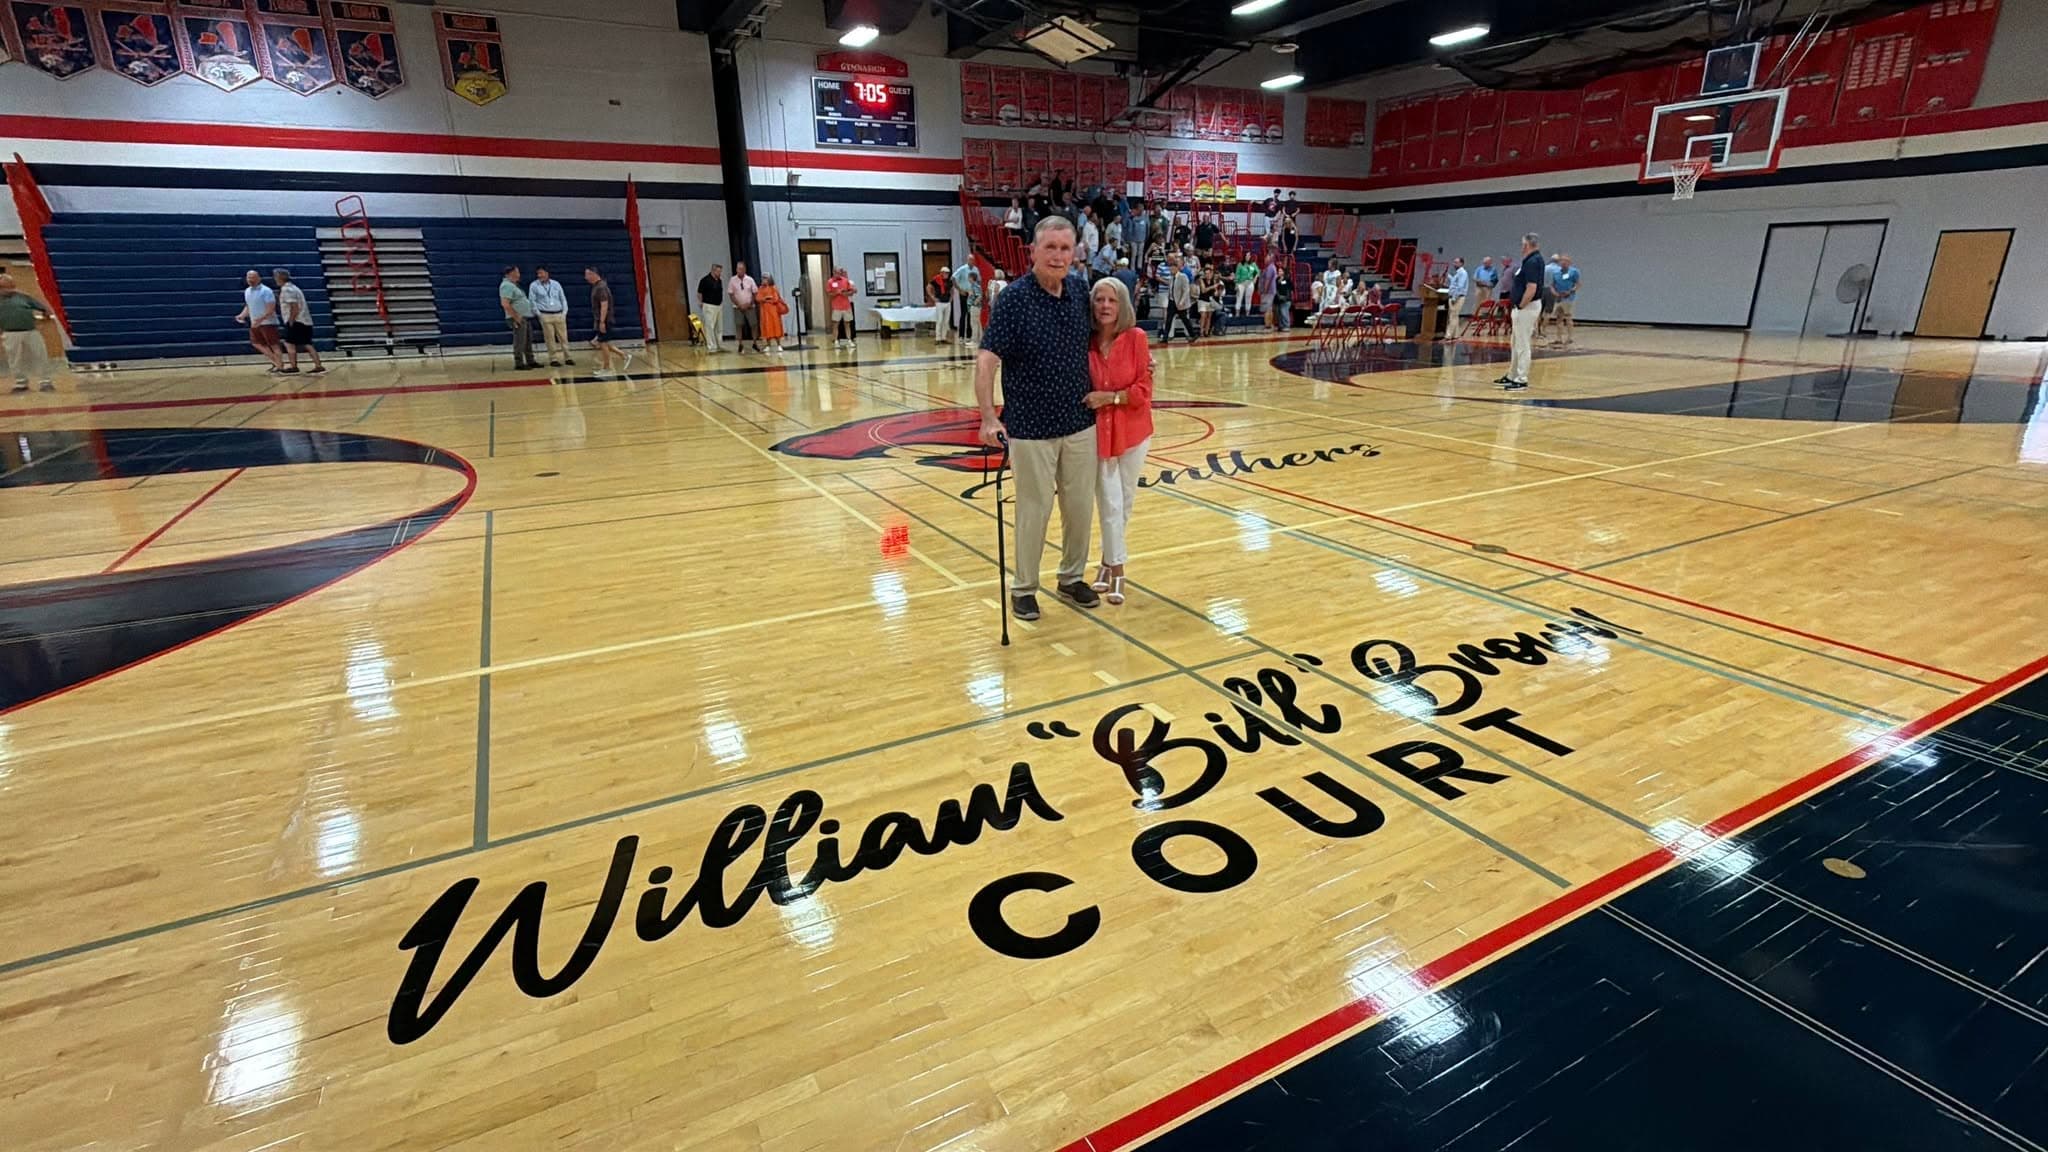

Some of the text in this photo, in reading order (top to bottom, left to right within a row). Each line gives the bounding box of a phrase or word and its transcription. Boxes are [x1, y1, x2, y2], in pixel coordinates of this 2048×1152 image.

[818, 81, 840, 90] HOME
[854, 82, 887, 103] 7:05
[889, 87, 911, 95] GUEST
[388, 762, 1065, 1046] William
[1350, 607, 1643, 717] Brown
[967, 708, 1574, 960] COURT
